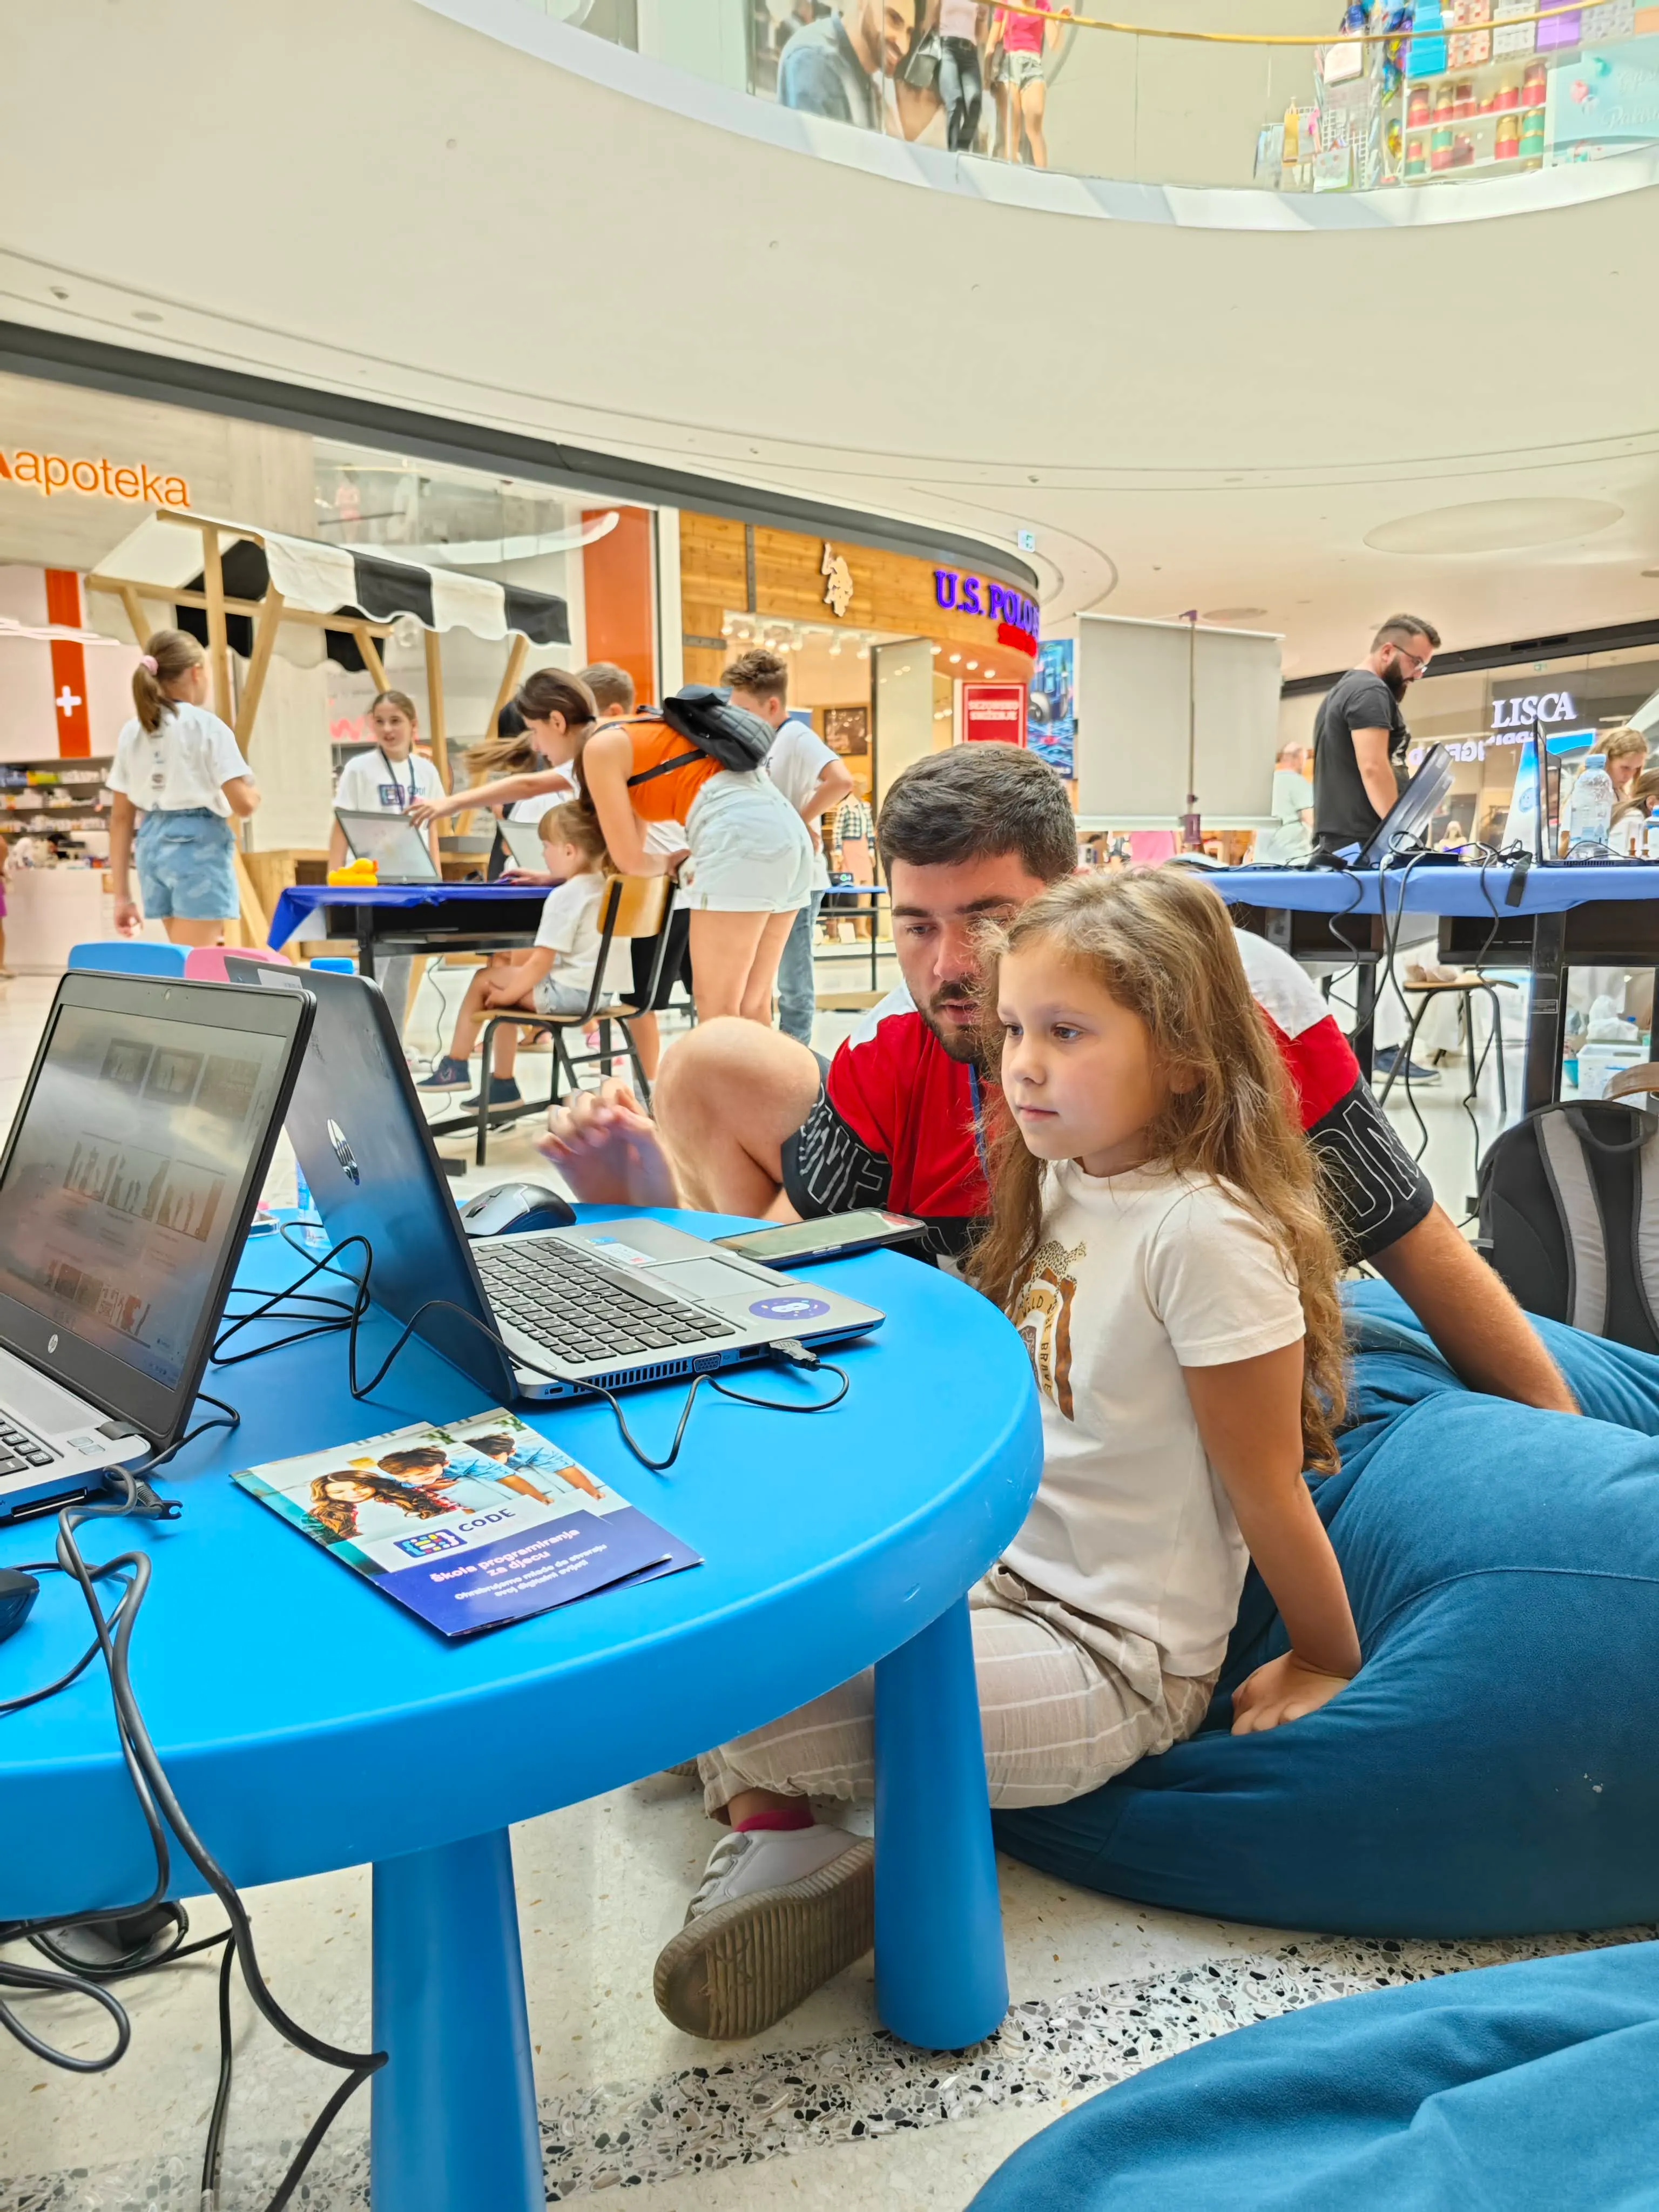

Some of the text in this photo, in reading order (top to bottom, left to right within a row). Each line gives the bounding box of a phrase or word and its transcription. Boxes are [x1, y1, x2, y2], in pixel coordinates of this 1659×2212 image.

[15, 451, 190, 507] apoteka
[935, 570, 985, 615] U.S.
[989, 583, 1033, 633] POLO
[1491, 691, 1577, 728] LISCA
[1040, 1343, 1052, 1391] BRAVE
[458, 1508, 516, 1532] CODE
[429, 1529, 580, 1582] Škola programiranja
[487, 1551, 551, 1576] za djecu
